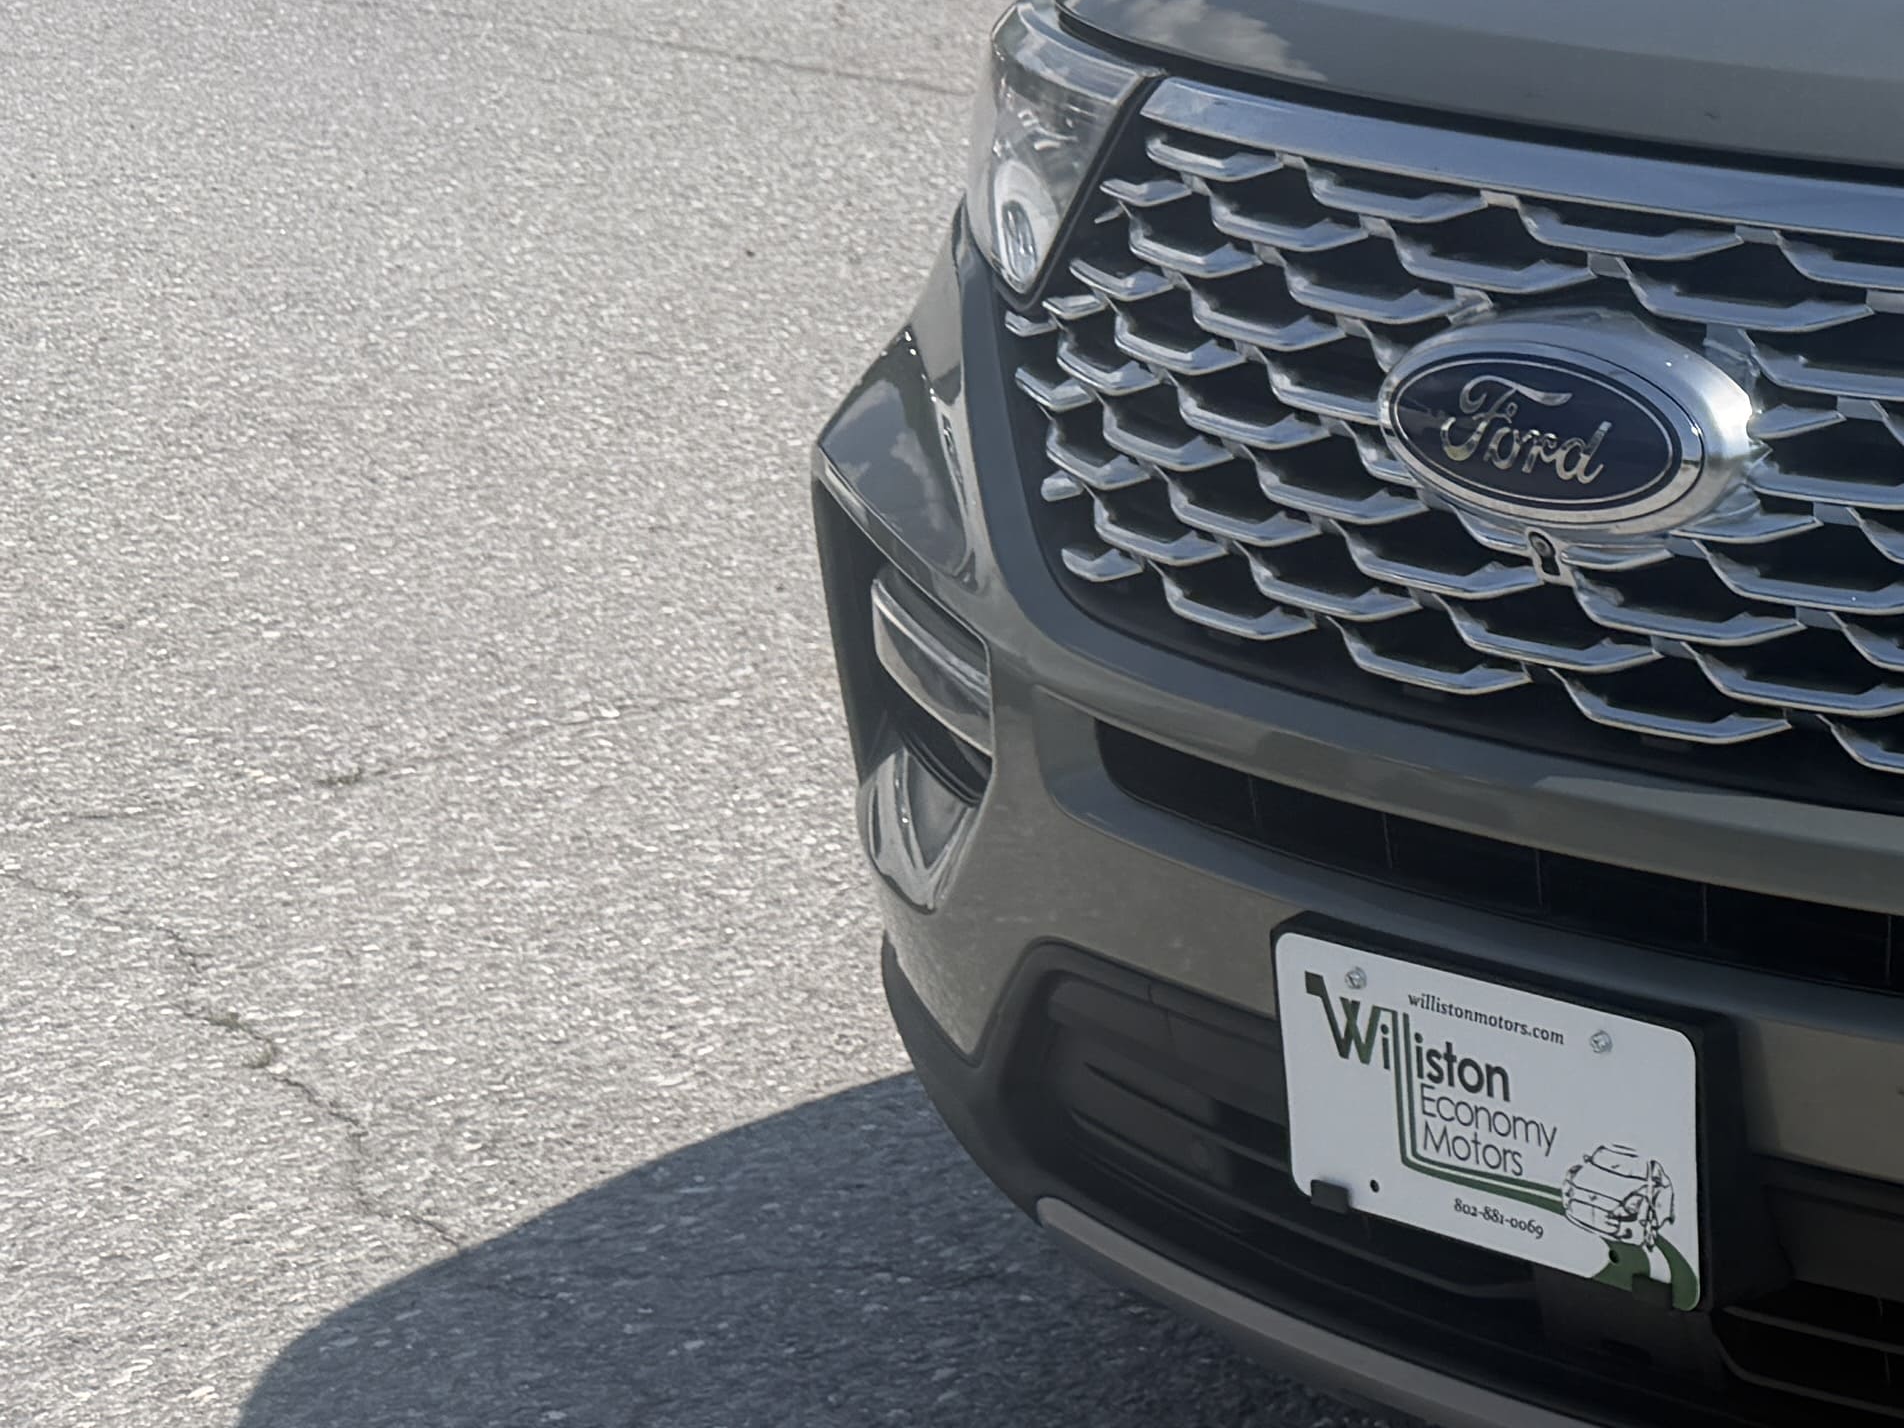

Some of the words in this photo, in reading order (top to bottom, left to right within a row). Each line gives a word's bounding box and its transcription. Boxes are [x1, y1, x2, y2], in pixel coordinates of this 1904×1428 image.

[1439, 374, 1613, 485] Ford
[1304, 970, 1511, 1103] Williston
[1407, 993, 1565, 1045] willistonmotors.com
[1419, 1083, 1558, 1158] Economy
[1423, 1120, 1523, 1178] Motors
[1453, 1197, 1545, 1240] 802-881-0069
